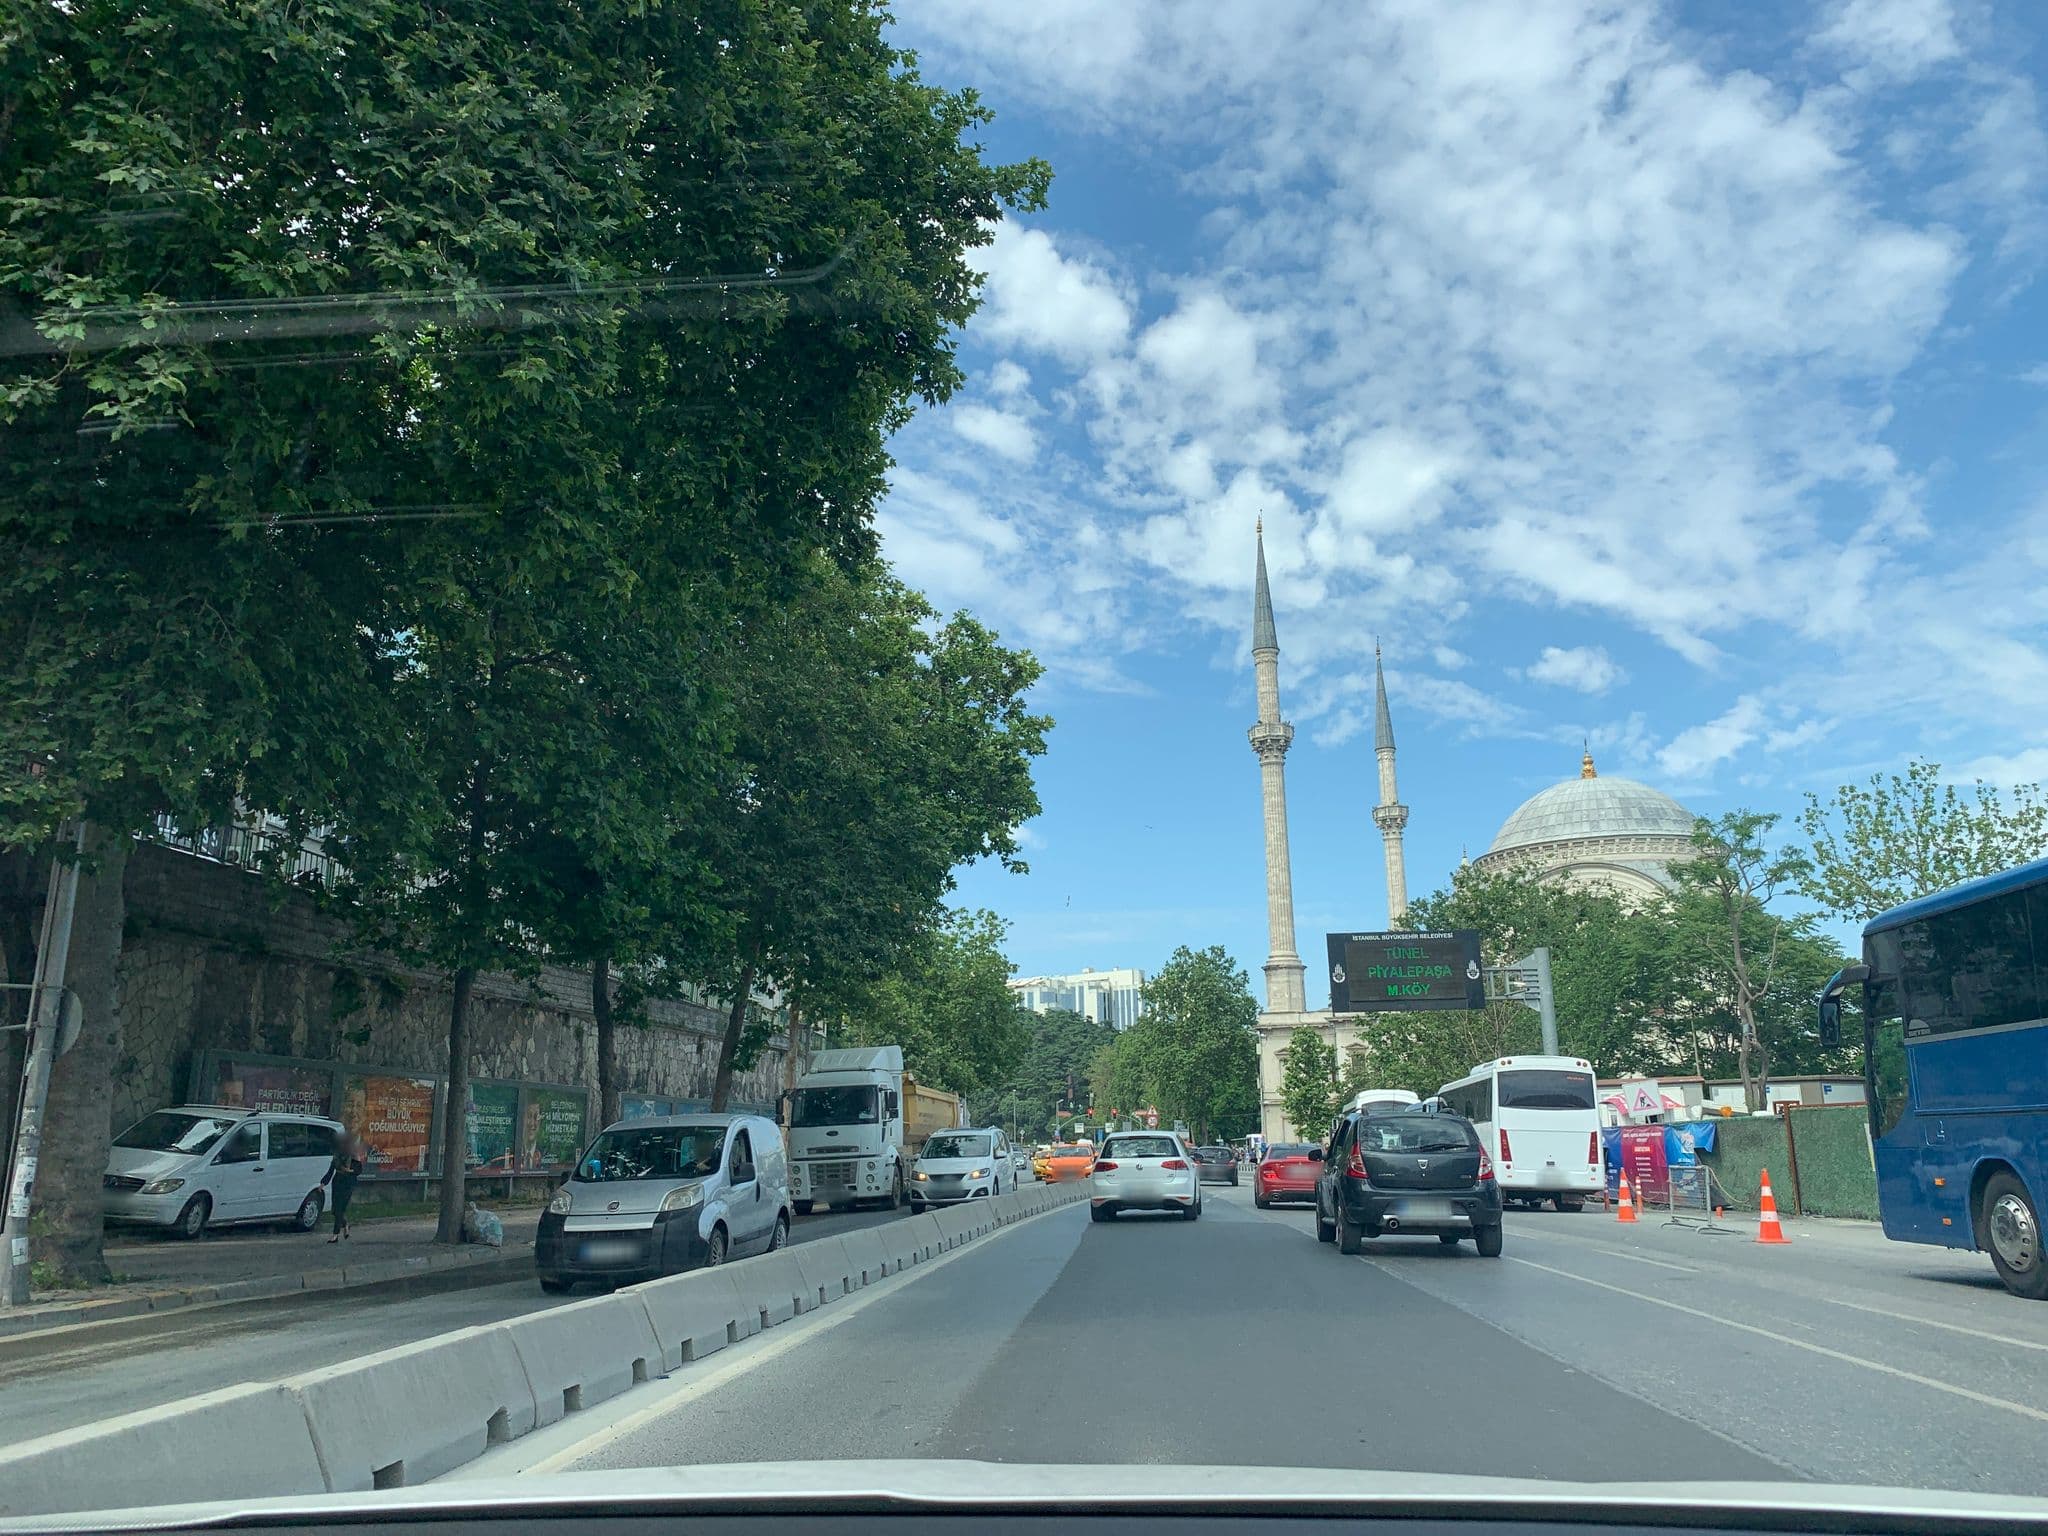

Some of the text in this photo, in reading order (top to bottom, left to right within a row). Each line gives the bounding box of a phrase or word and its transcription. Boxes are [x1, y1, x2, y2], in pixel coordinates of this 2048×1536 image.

[1384, 947, 1429, 960] TÜNEL
[1368, 964, 1452, 979] PİYALEPAŞA
[1387, 982, 1431, 996] M.KÖY
[258, 1088, 298, 1101] PARTİCİLİK
[254, 1101, 321, 1115] BELEDİYECİLİK
[386, 1106, 412, 1120] BÜYÜK
[368, 1119, 426, 1135] ÇOĞUNLUĞUYUZ
